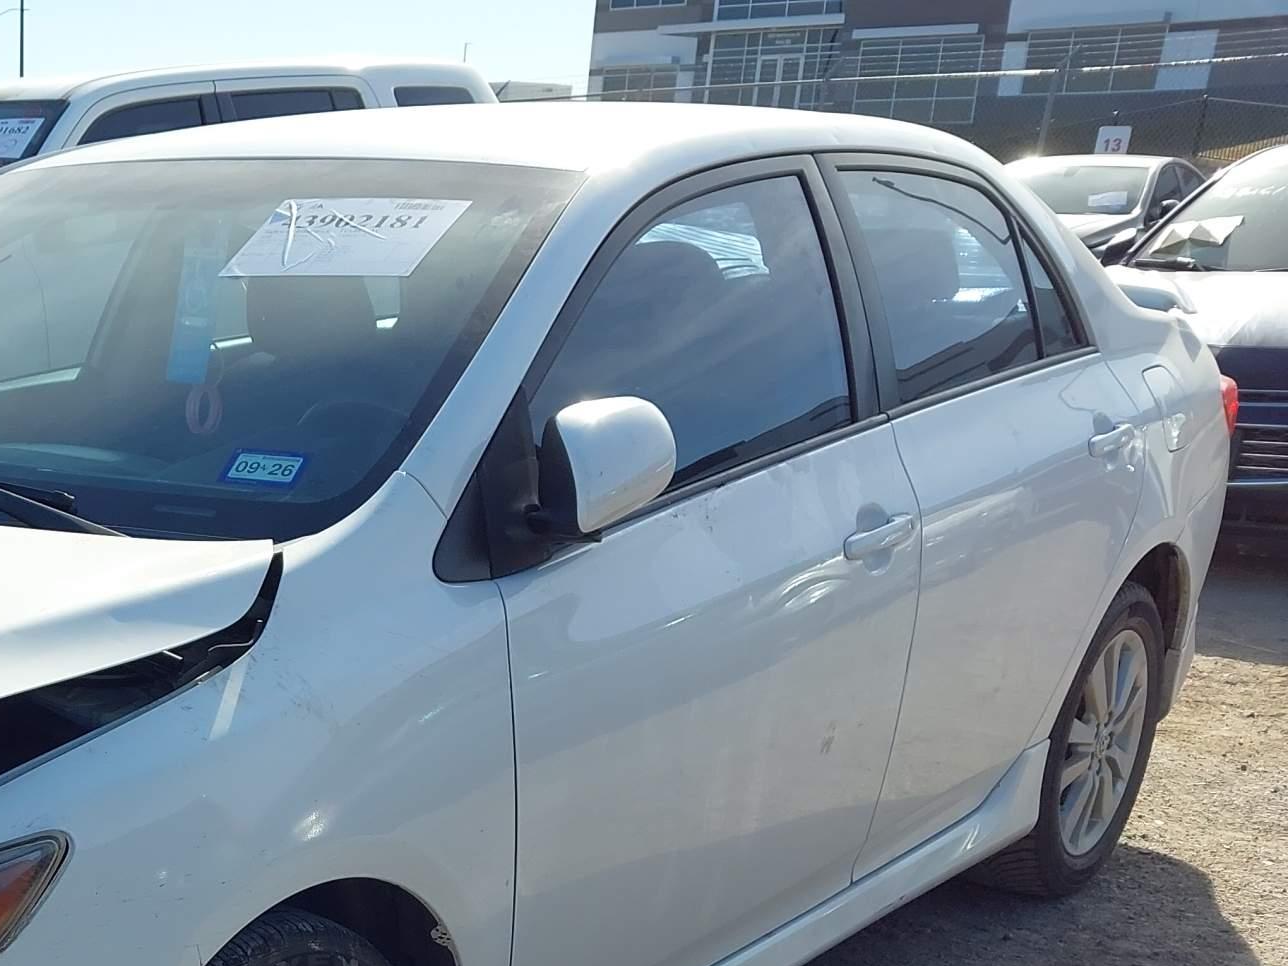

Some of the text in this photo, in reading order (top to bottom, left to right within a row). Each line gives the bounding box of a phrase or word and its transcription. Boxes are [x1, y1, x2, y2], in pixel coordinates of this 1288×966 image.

[1103, 138, 1123, 152] 13
[234, 460, 296, 477] 09 26
